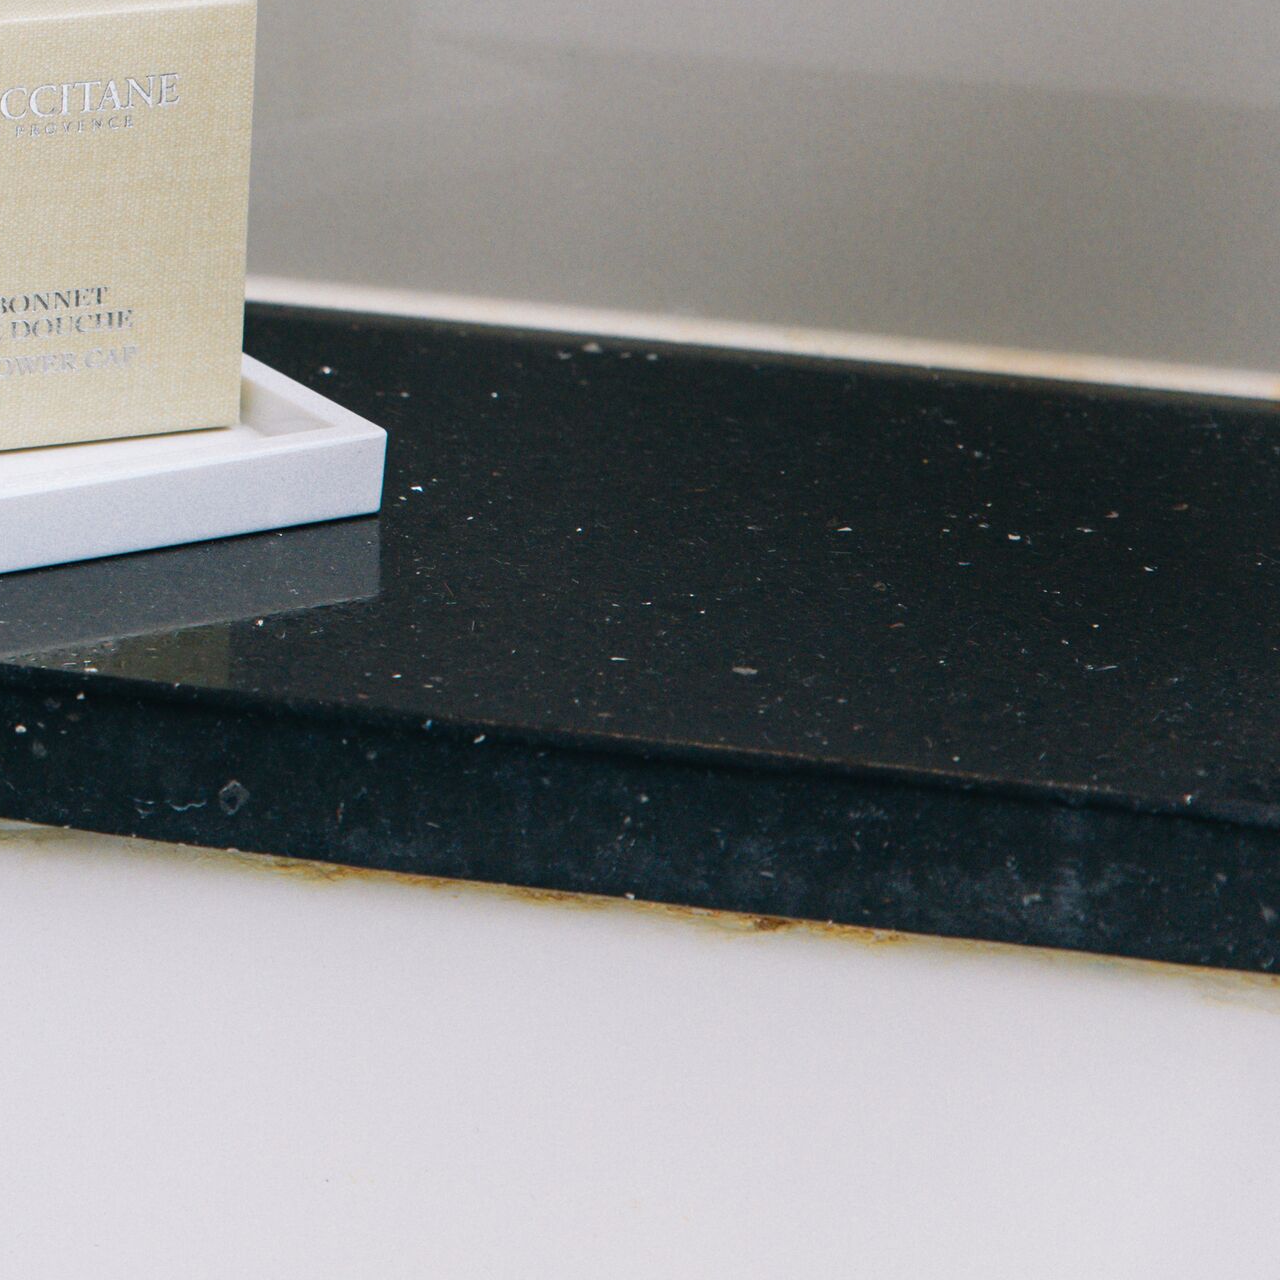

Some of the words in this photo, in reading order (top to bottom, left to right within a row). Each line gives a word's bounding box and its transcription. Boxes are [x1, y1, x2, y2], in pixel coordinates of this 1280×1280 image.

[15, 115, 135, 138] PROVENCE
[11, 309, 134, 341] DOUCHE
[83, 344, 140, 369] CAP
